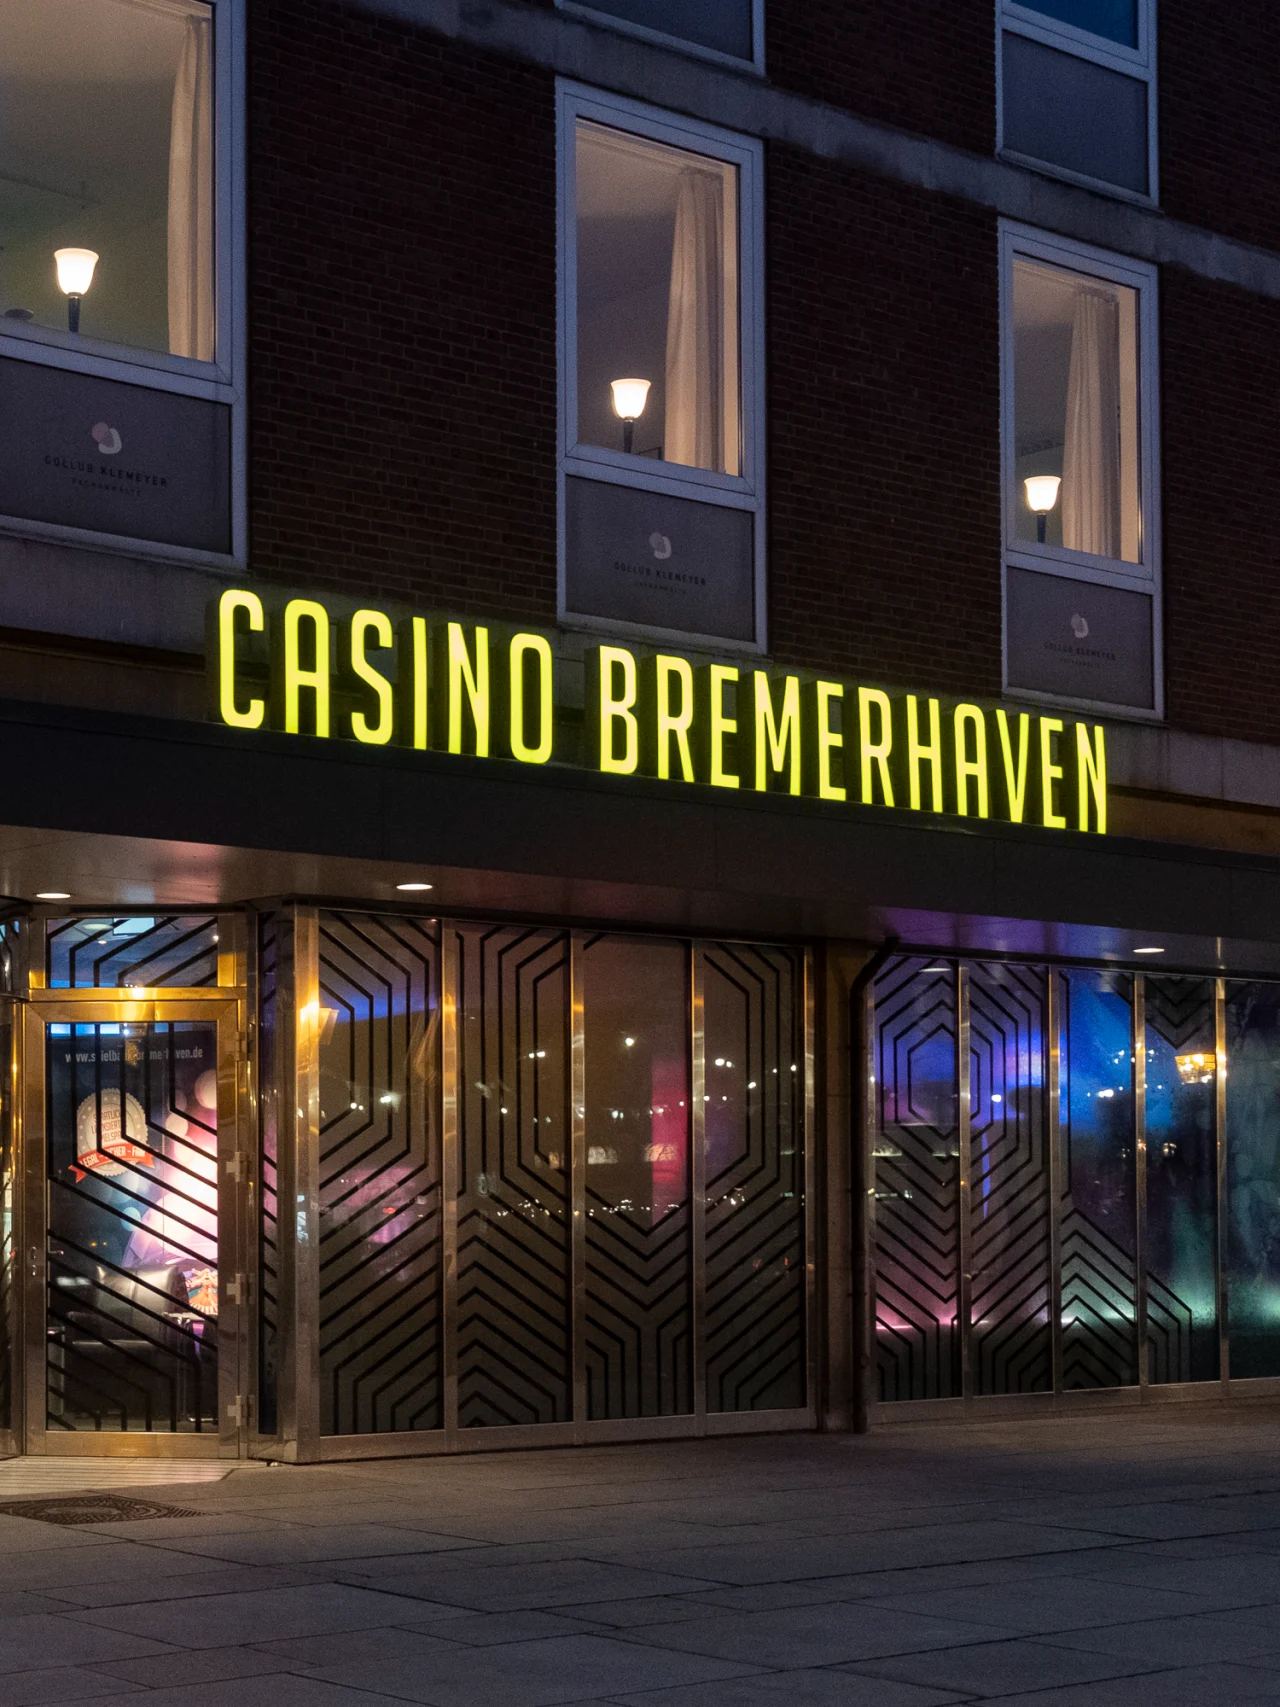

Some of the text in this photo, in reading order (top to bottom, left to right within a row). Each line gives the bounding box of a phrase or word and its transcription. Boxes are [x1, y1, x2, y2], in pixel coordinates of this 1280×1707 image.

[100, 466, 168, 487] KLEMEYER
[218, 588, 1108, 835] CASINO BREMERHAVEN
